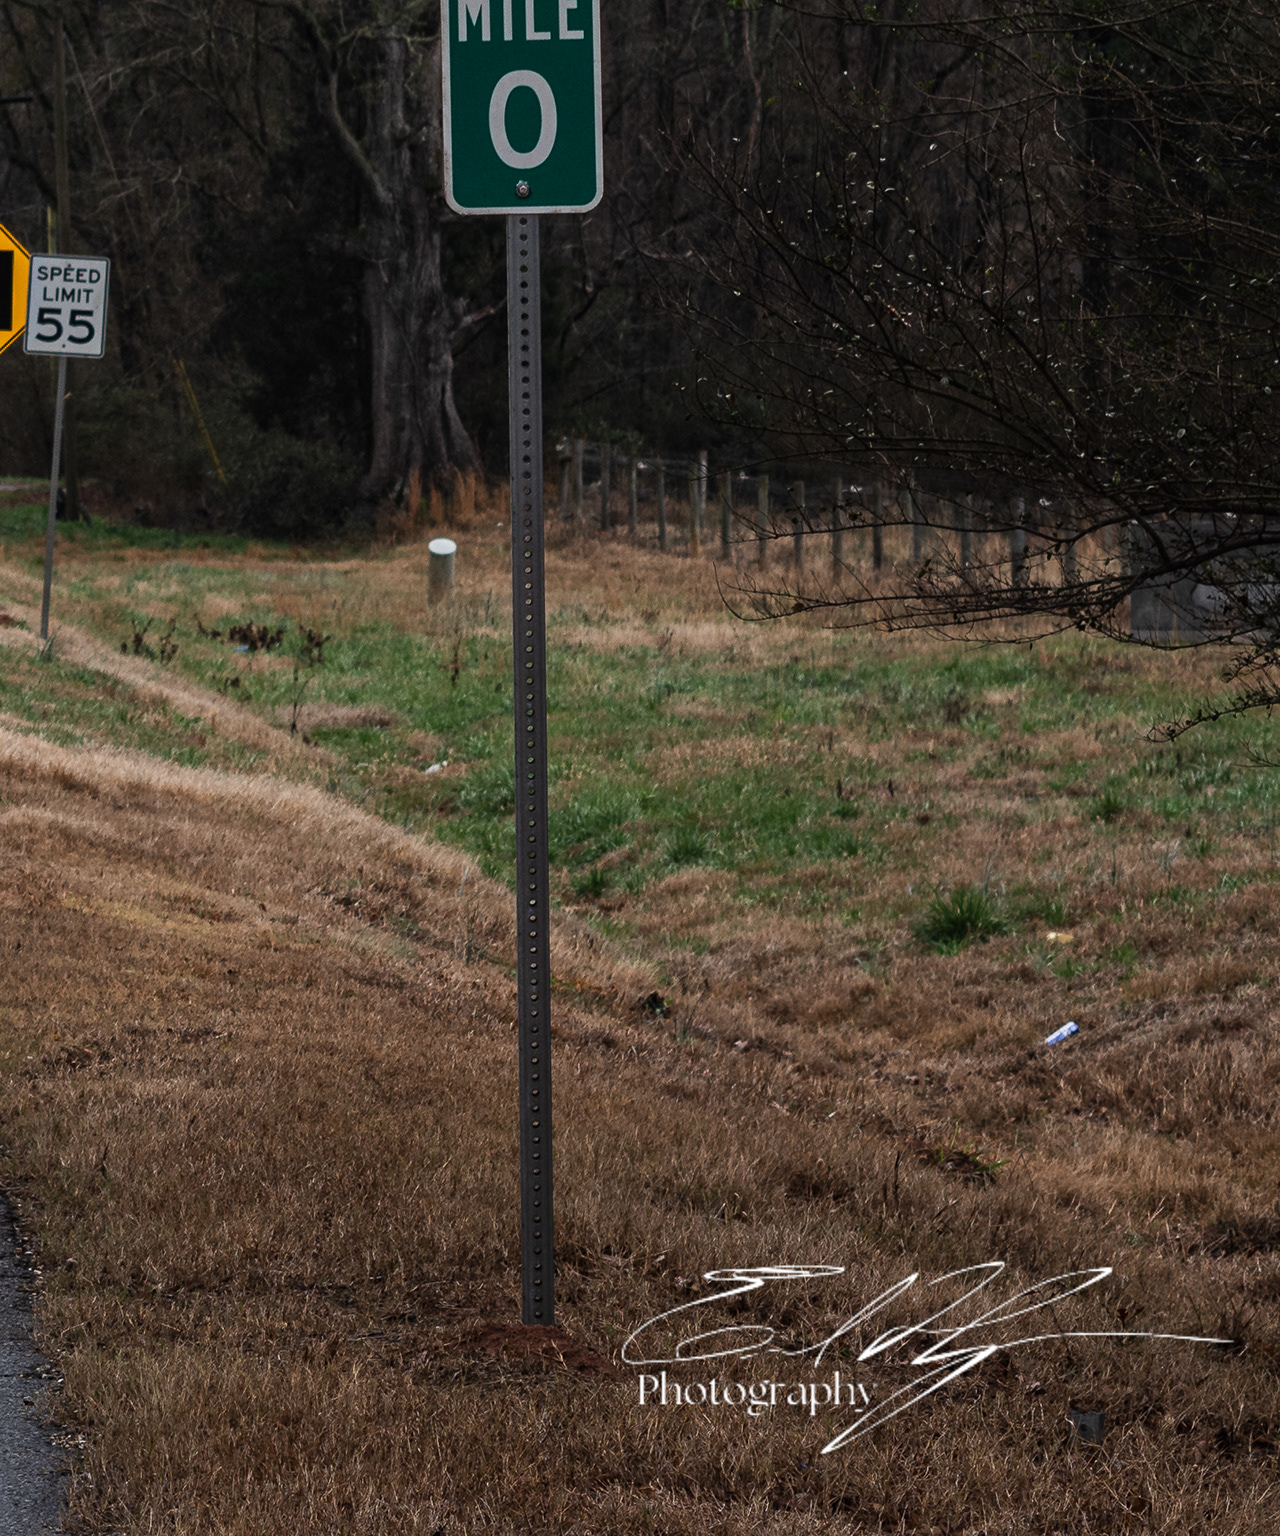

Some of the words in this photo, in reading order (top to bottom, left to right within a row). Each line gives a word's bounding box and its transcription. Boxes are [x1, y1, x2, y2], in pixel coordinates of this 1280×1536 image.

[488, 69, 557, 169] 0
[37, 266, 101, 284] SPEED
[42, 286, 94, 304] LIMIT
[35, 307, 96, 345] 55
